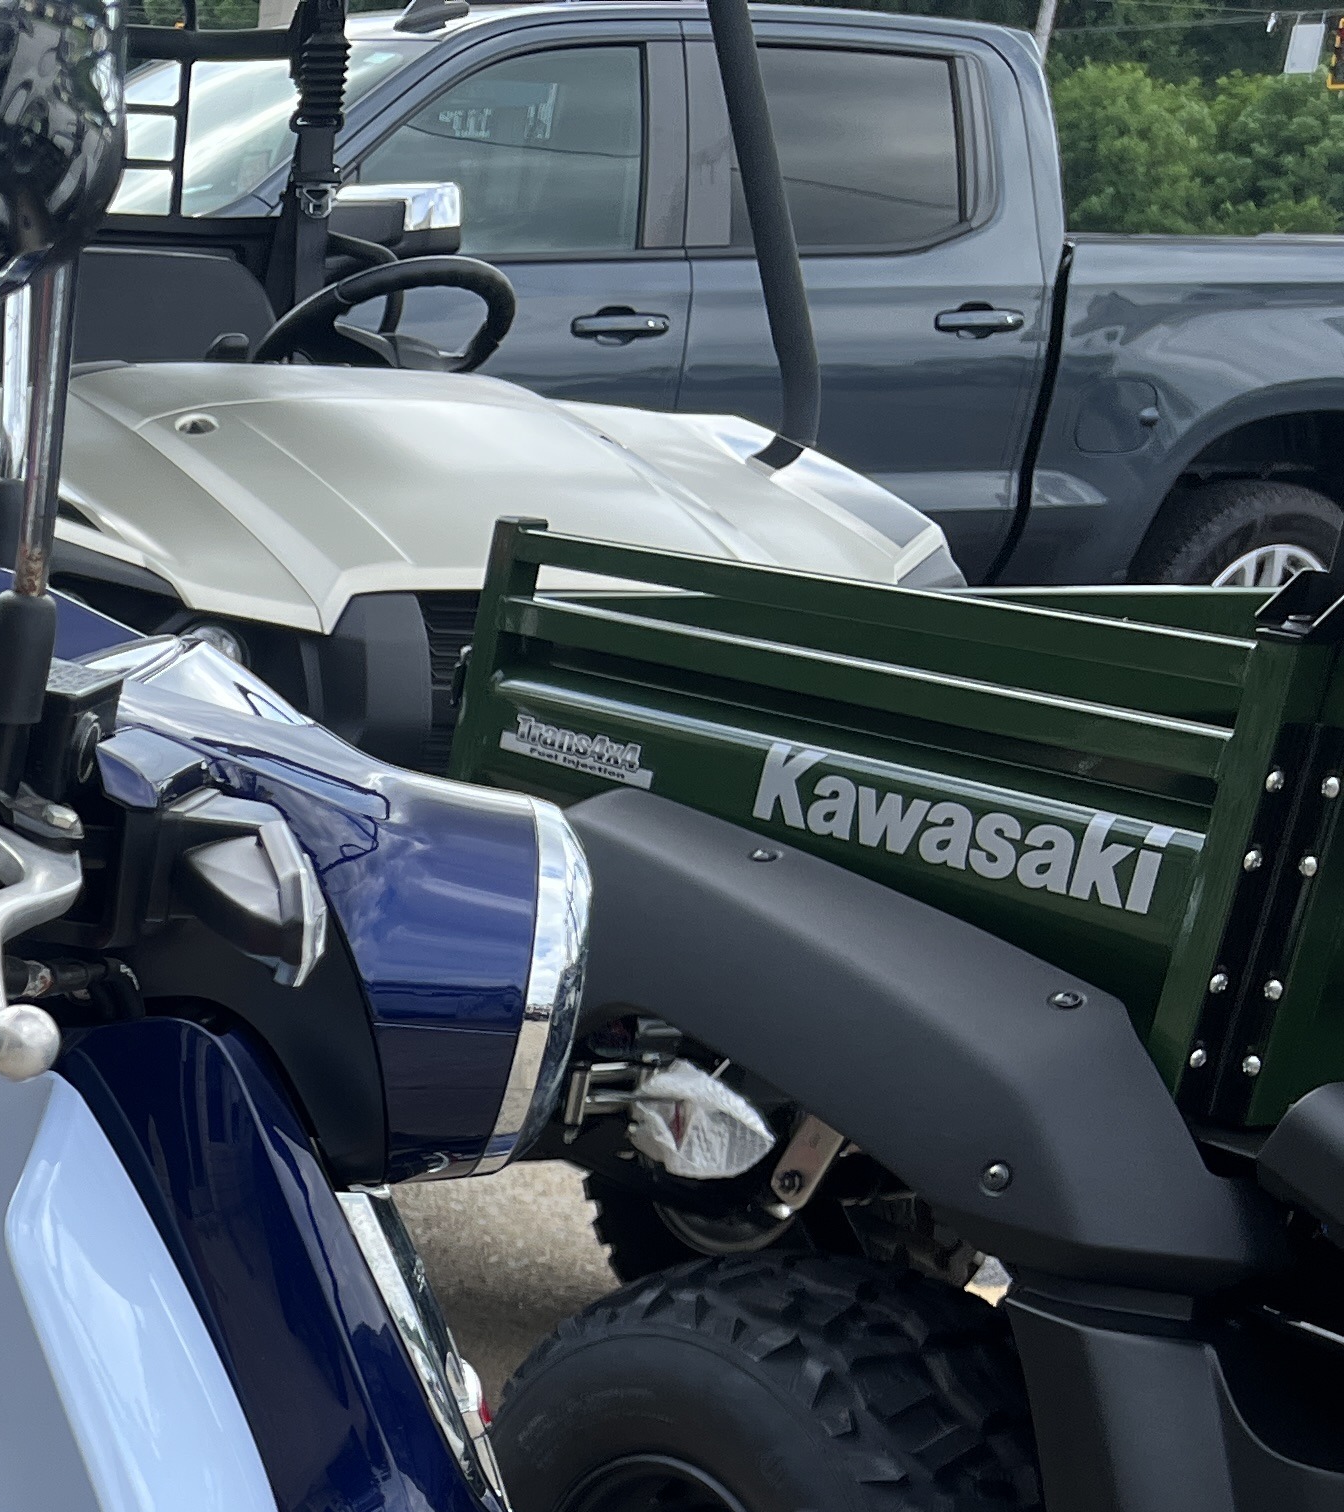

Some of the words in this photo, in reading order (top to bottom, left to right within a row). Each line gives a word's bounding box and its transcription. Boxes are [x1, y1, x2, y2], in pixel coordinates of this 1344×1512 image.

[516, 713, 642, 773] Trans4x4
[529, 747, 559, 761] Fuel
[562, 755, 625, 779] Injection
[752, 743, 1176, 914] Kawasaki
